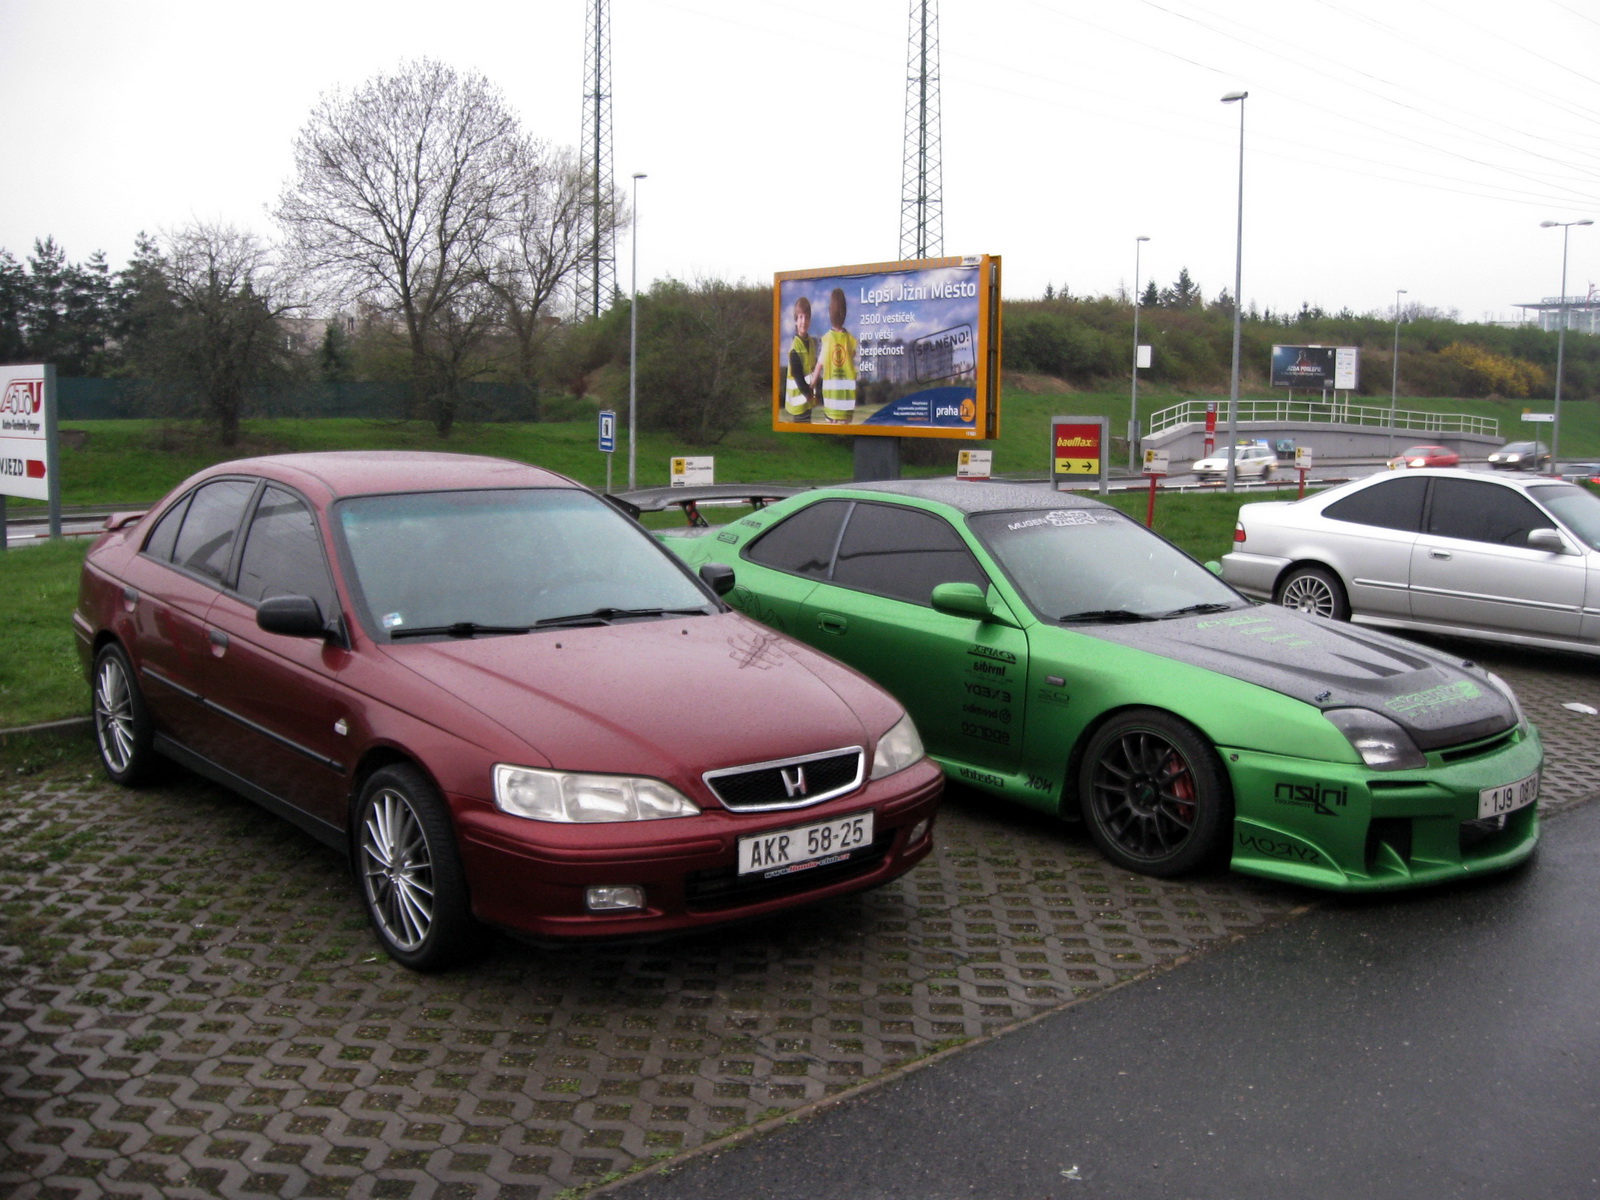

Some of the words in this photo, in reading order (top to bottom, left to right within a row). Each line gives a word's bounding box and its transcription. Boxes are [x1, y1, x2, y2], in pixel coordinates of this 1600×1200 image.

[860, 284, 893, 307] Lepší
[897, 282, 927, 302] Jižní
[931, 280, 976, 299] Město
[860, 314, 880, 325] 2500
[860, 332, 873, 342] pro
[916, 330, 970, 356] SPLNĚNO!
[860, 345, 904, 357] bezpečnost
[936, 405, 958, 418] praha
[1008, 518, 1048, 531] MUGEN
[1492, 788, 1513, 812] 1J9
[751, 835, 790, 868] AKR
[808, 818, 864, 854] 58-25
